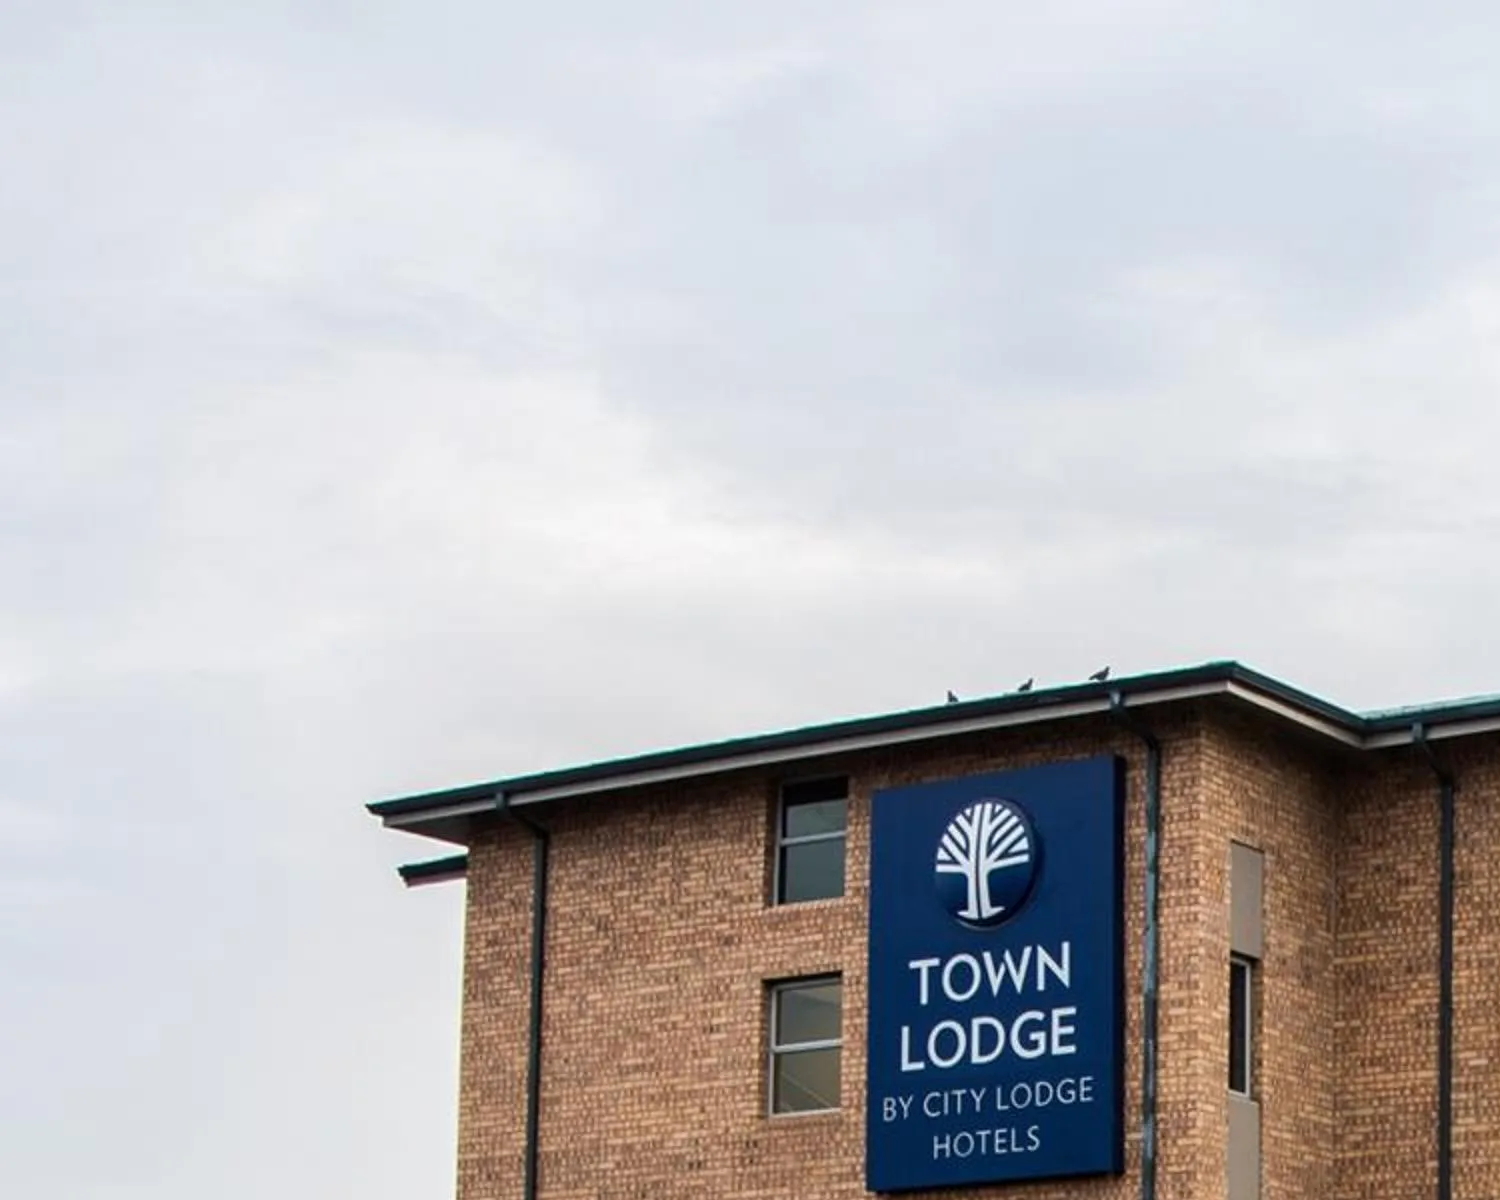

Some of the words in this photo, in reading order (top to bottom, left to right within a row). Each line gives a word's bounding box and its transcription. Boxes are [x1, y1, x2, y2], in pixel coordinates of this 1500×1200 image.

[908, 941, 1070, 1005] TOWN
[901, 1006, 1077, 1072] LODGE
[883, 1096, 912, 1121] BY
[923, 1088, 985, 1118] CITY
[997, 1076, 1093, 1110] LODGE
[933, 1125, 1040, 1159] HOTELS
